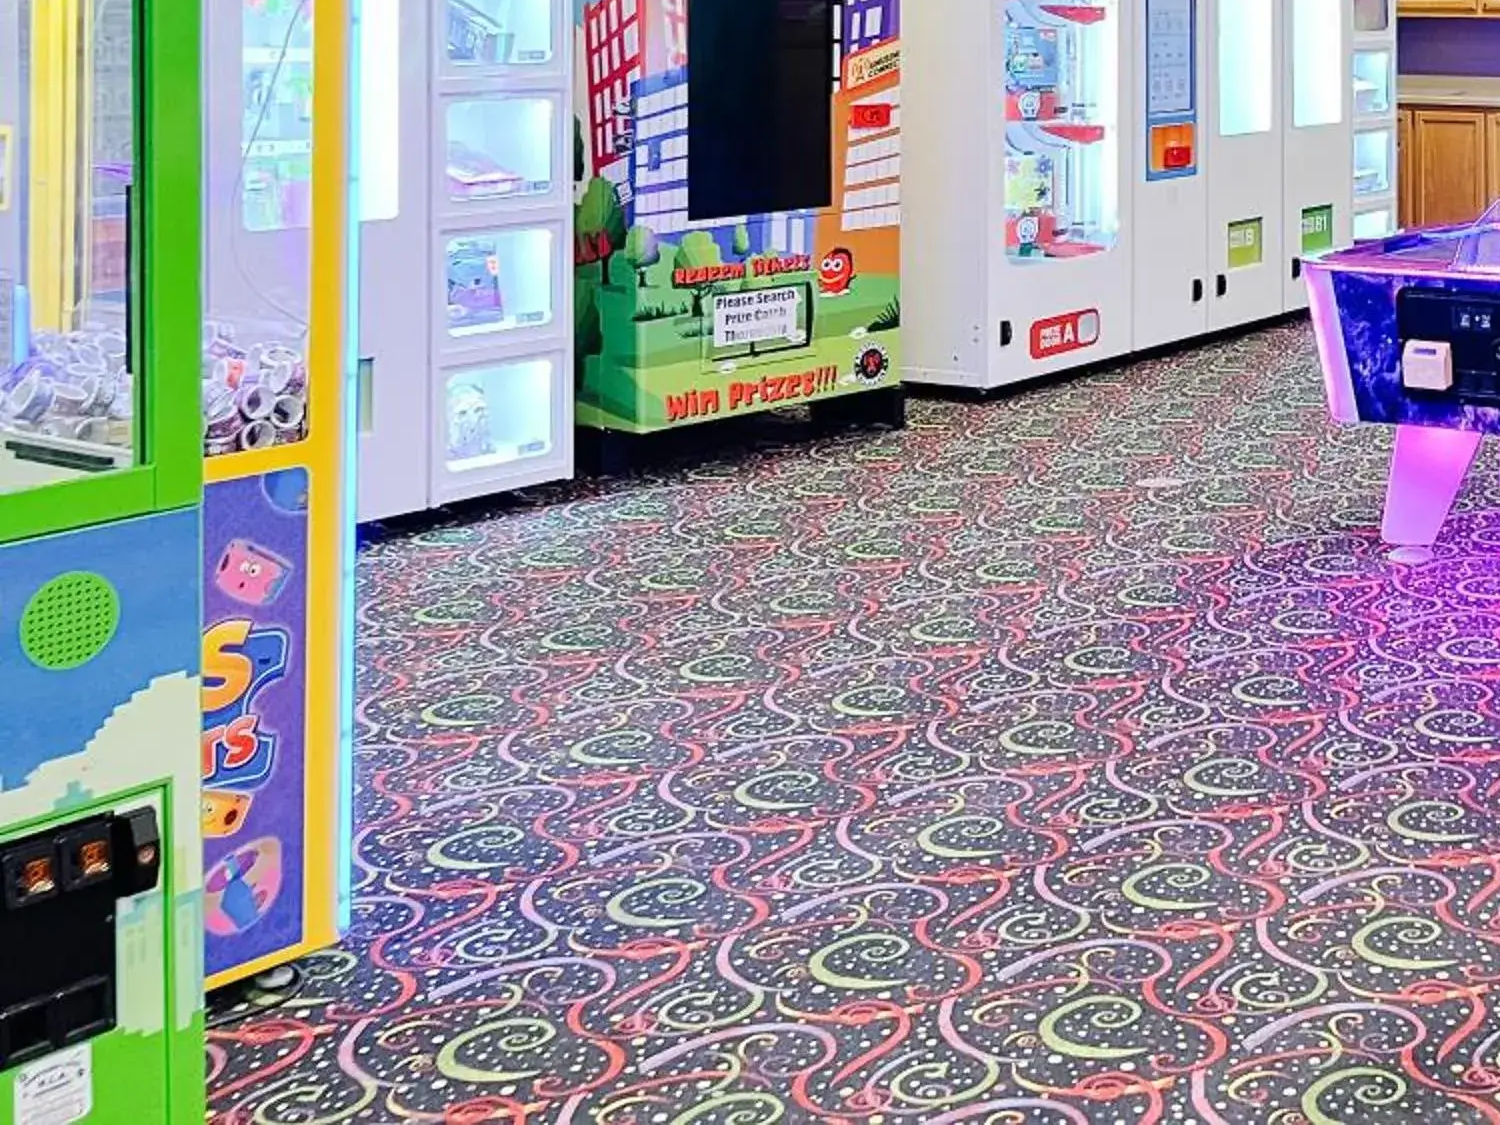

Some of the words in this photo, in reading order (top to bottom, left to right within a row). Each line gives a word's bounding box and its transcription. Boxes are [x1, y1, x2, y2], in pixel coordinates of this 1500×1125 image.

[716, 294, 755, 309] Please
[756, 289, 796, 305] Search
[725, 311, 753, 326] Prize
[1063, 322, 1076, 344] A
